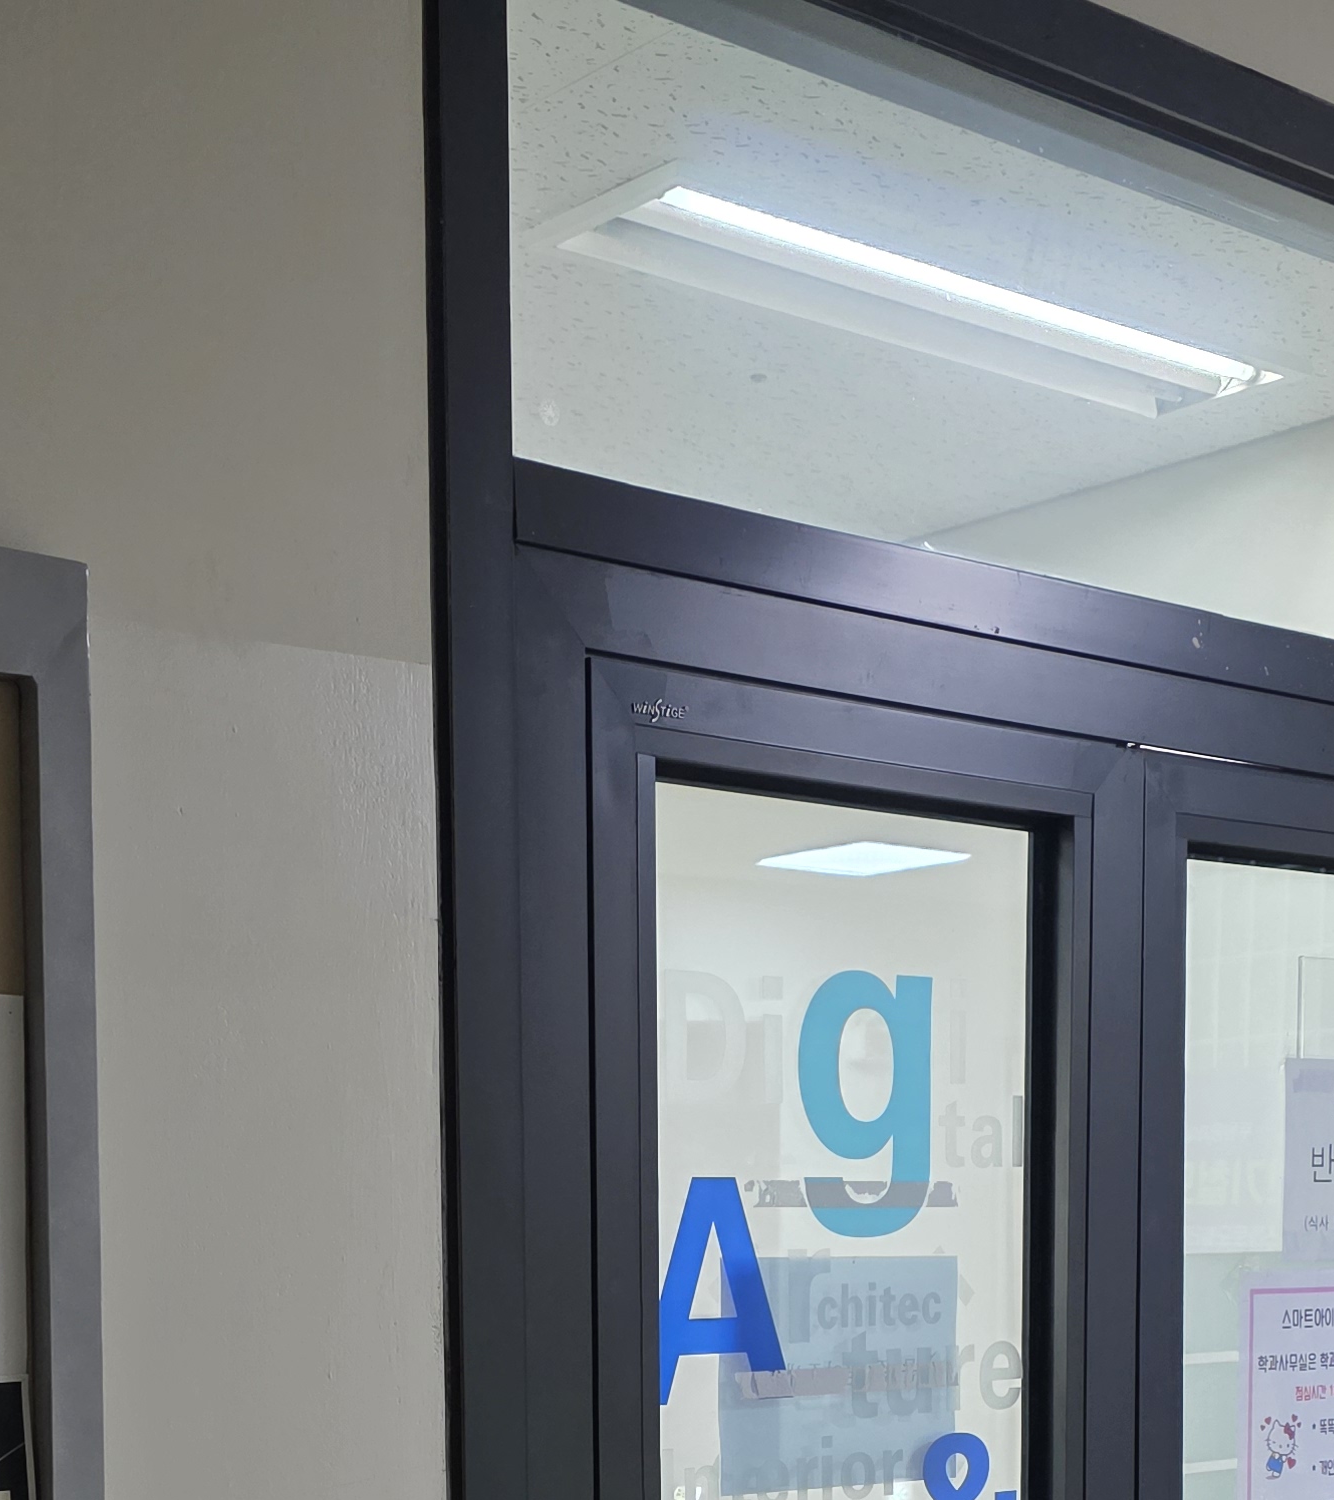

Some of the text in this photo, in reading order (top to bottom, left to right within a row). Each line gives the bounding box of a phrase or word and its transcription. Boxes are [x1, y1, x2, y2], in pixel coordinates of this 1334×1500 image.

[1304, 1215, 1329, 1231] (식사
[1257, 1353, 1316, 1373] 학과사무실은
[1295, 1384, 1326, 1401] 점심시간
[1319, 1418, 1334, 1434] 똑똑
[1319, 1459, 1334, 1476] 개인
